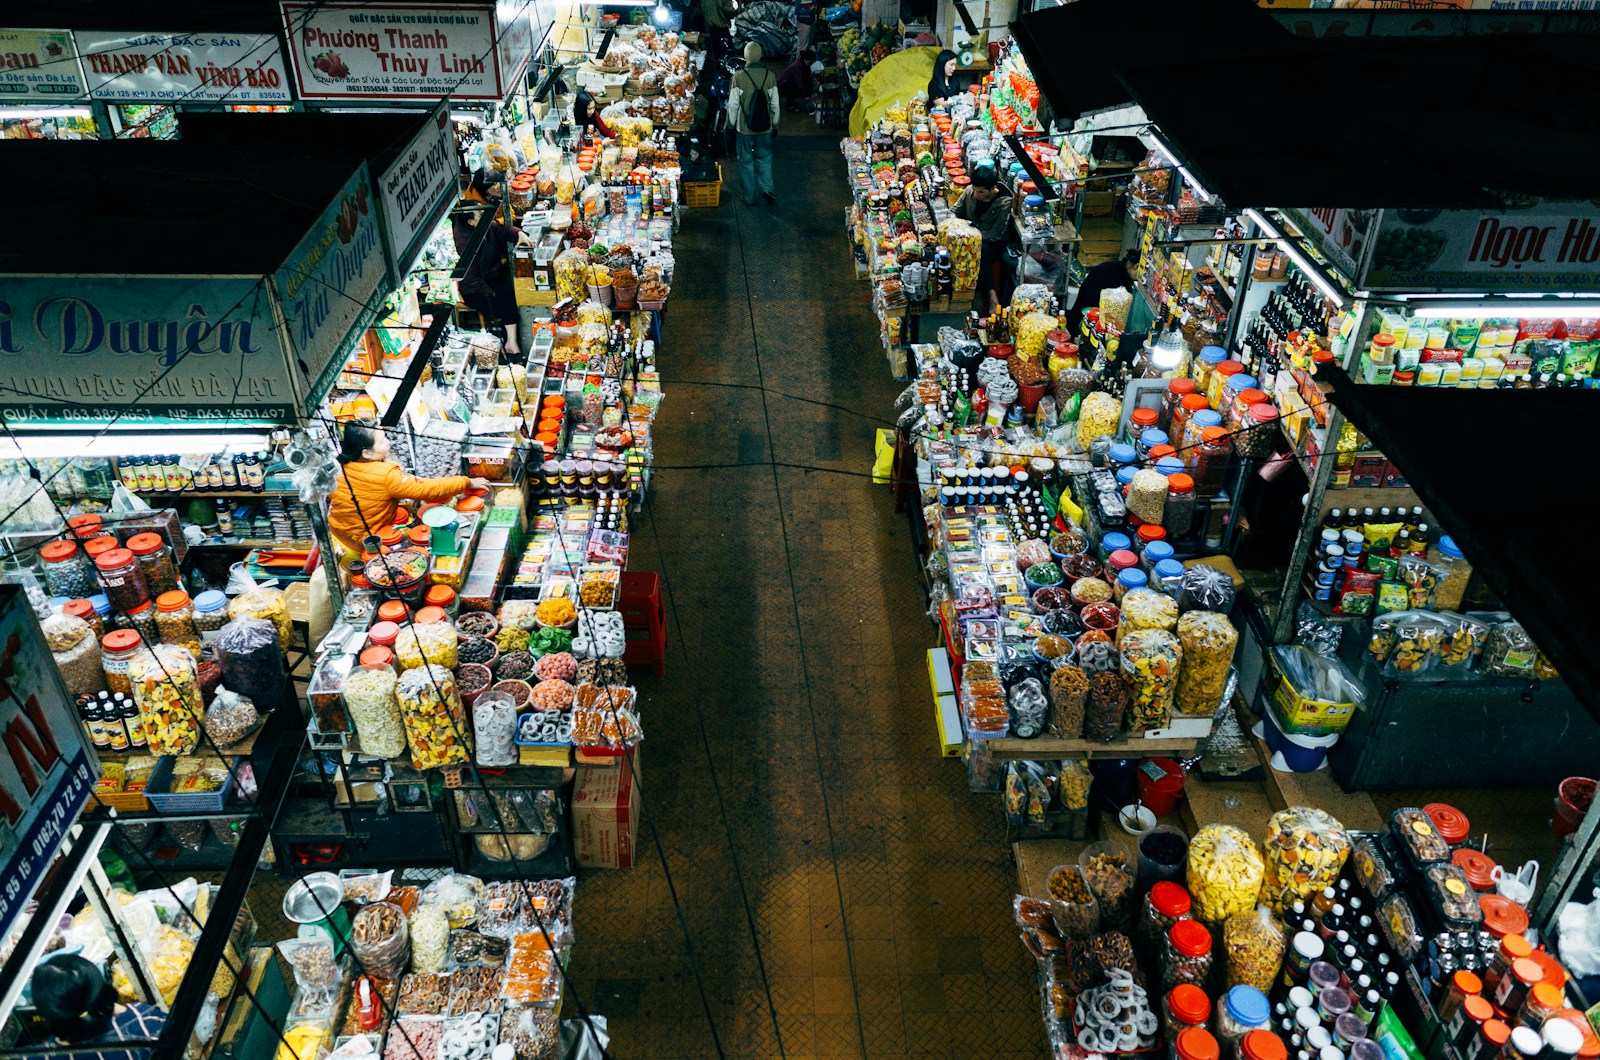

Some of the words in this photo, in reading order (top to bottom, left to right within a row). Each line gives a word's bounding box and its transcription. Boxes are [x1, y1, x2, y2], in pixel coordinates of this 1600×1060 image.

[304, 27, 380, 53] Phương
[384, 28, 448, 49] Thanh
[86, 53, 148, 74] THANH
[377, 52, 428, 77] Thùy
[440, 53, 485, 74] Linh
[118, 90, 130, 98] 125
[396, 159, 428, 222] THANH
[1468, 217, 1556, 270] Ngọc
[330, 221, 376, 298] Duyên
[34, 296, 263, 367] Duyên
[61, 785, 76, 808] 72
